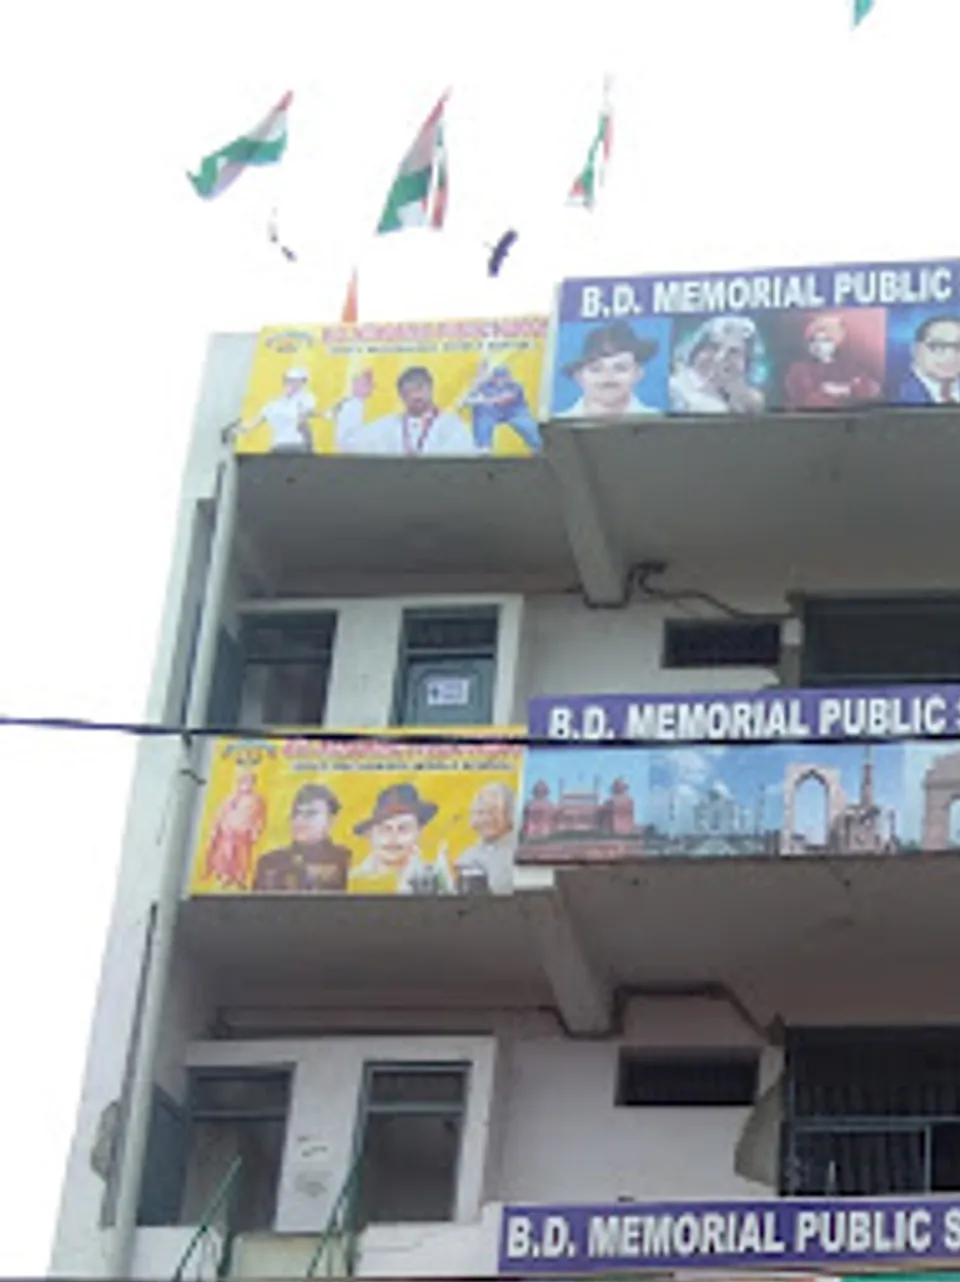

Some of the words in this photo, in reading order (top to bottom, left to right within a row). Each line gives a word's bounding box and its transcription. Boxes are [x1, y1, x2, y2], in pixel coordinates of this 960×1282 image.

[581, 287, 643, 318] B.D.
[652, 275, 825, 314] MEMORIAL
[832, 267, 953, 306] PUBLIC
[547, 707, 614, 741] B.D.
[626, 698, 810, 739] MEMORIAL
[818, 694, 949, 735] PUBLIC
[506, 1217, 576, 1258] B.D.
[587, 1212, 785, 1256] MEMORIAL
[794, 1209, 936, 1252] PUBLIC
